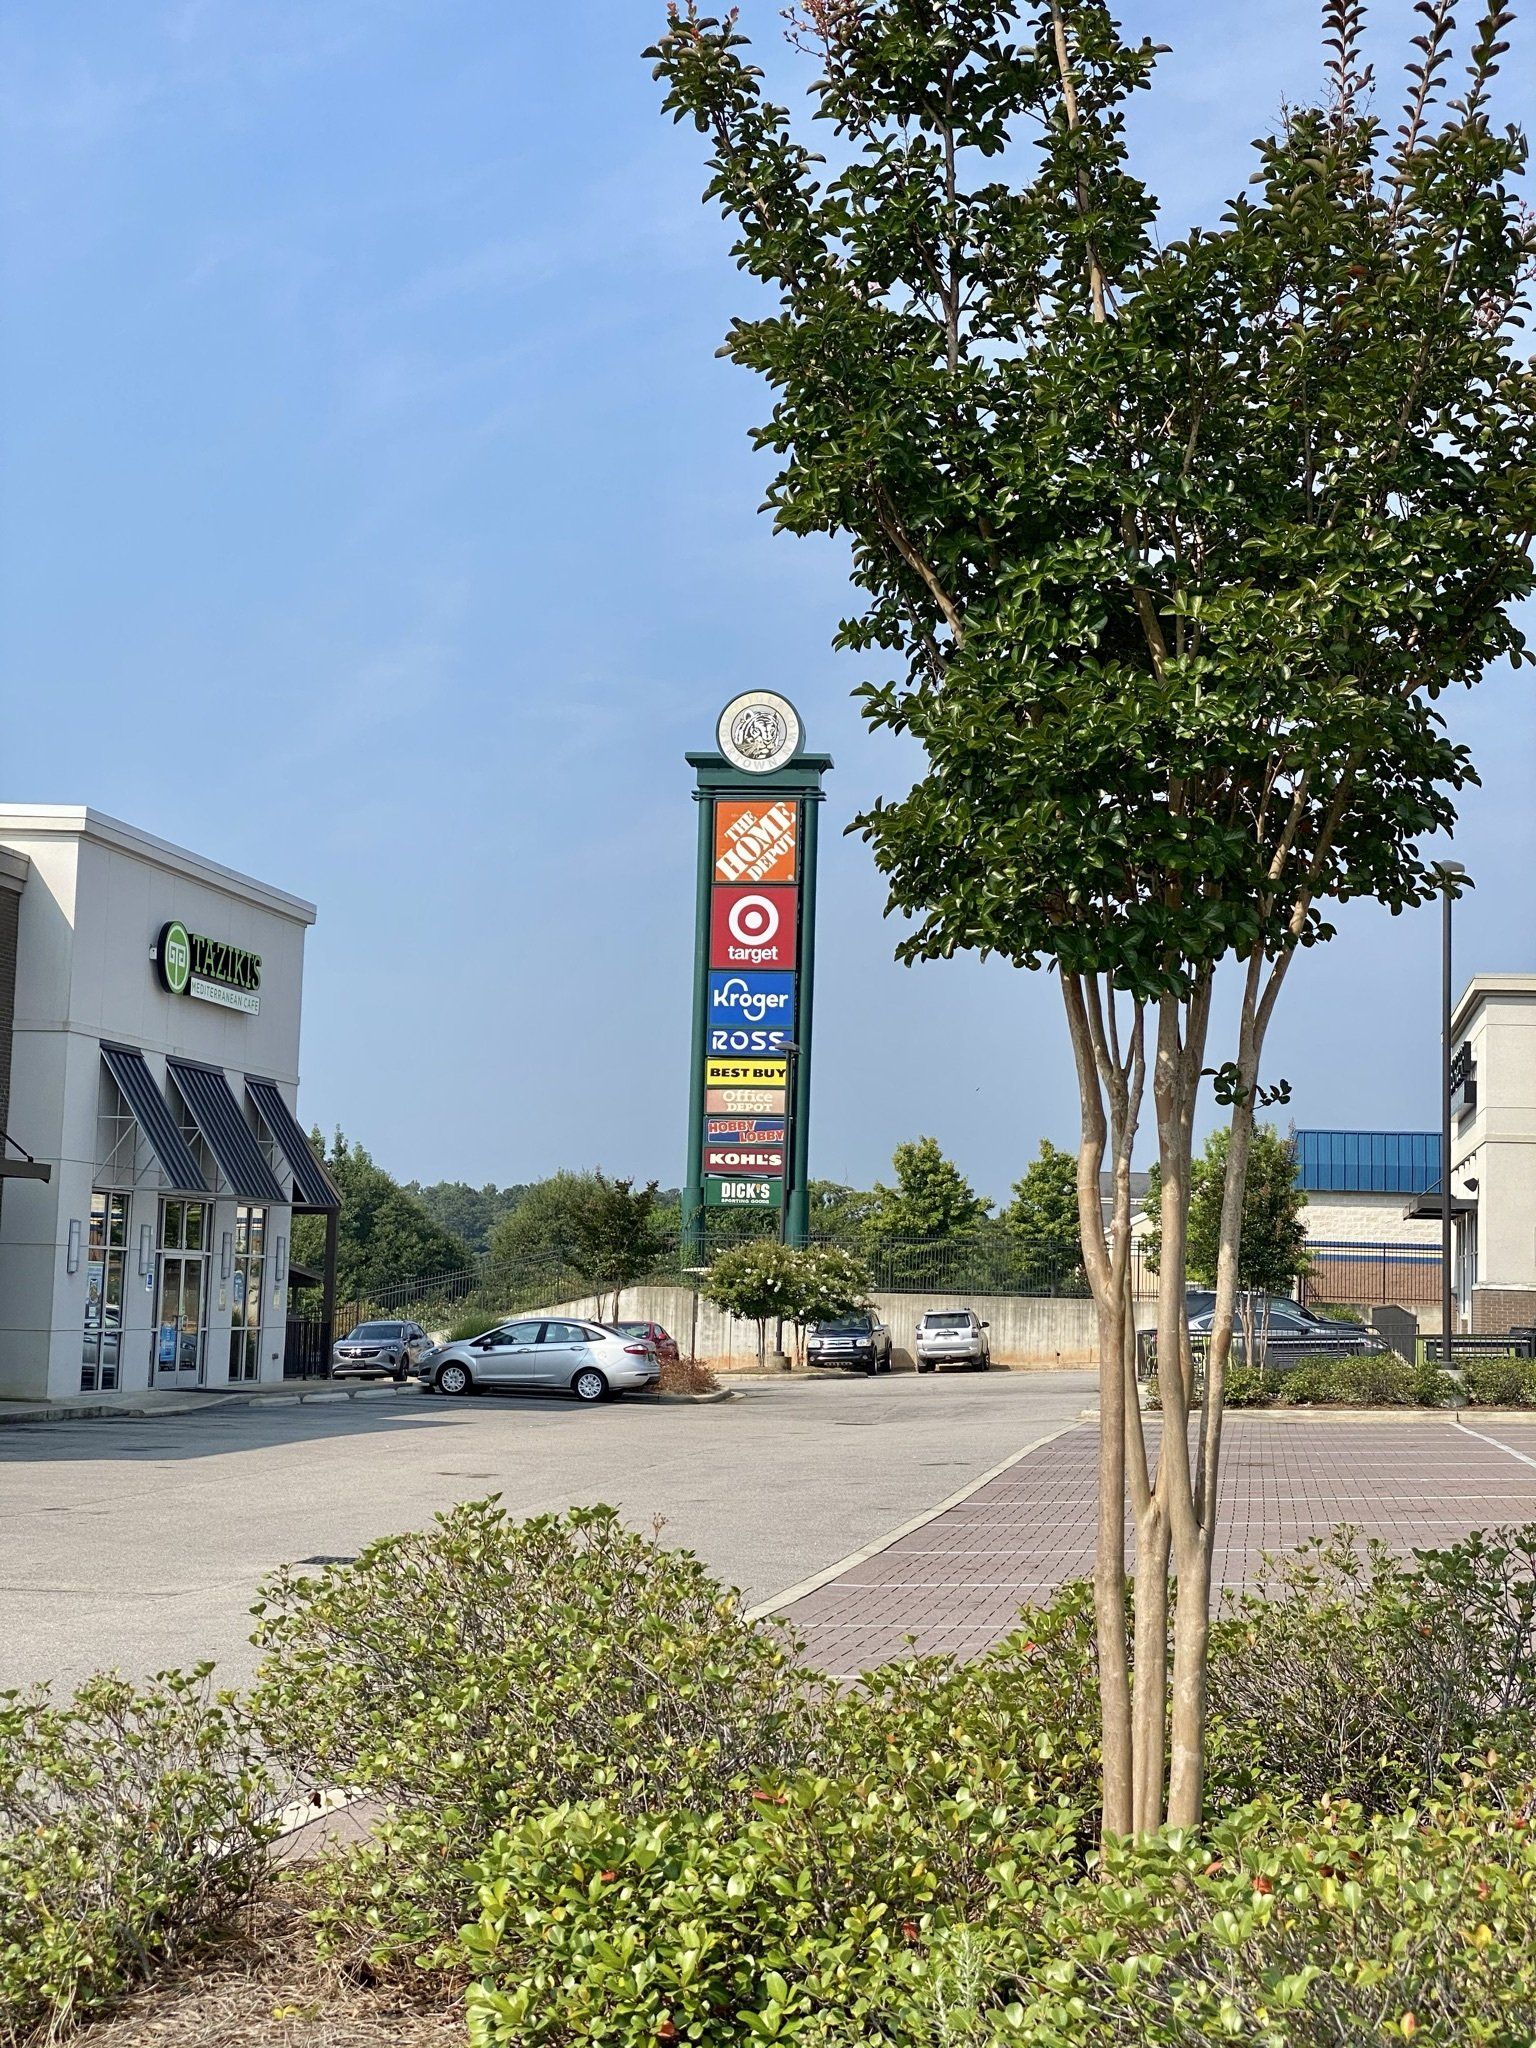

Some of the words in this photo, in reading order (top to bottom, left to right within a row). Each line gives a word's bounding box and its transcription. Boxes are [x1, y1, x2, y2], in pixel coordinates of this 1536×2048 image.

[724, 810, 758, 842] THE
[716, 802, 796, 881] HOME
[746, 831, 796, 881] DEPOT
[192, 933, 262, 990] TAZIKI'S
[728, 945, 778, 963] target
[191, 981, 243, 1006] MEDITERRANEAN
[713, 978, 789, 1021] Kroger
[712, 1030, 785, 1051] ROSS
[710, 1068, 750, 1077] BEST
[753, 1068, 786, 1077] BUY
[723, 1089, 773, 1102] Office
[726, 1102, 773, 1112] DEPOT
[708, 1119, 756, 1133] HOBBY
[739, 1130, 784, 1143] LOBBY
[709, 1153, 782, 1166] KOHL'S
[721, 1182, 770, 1199] DICK'S
